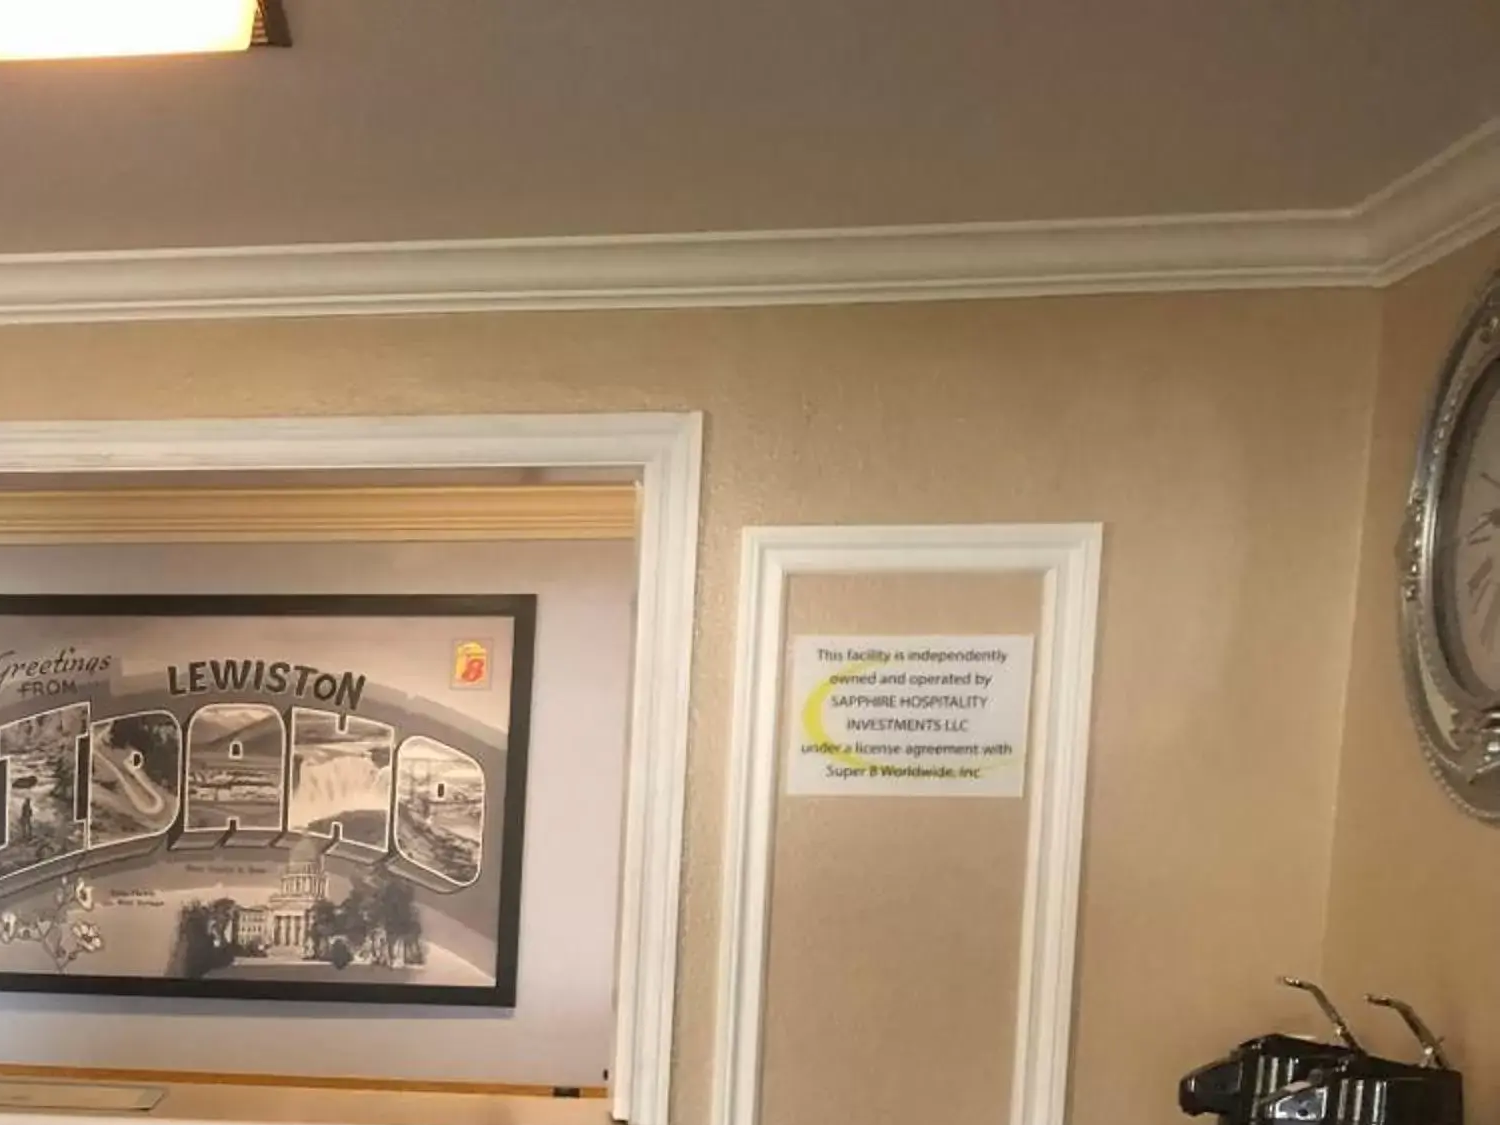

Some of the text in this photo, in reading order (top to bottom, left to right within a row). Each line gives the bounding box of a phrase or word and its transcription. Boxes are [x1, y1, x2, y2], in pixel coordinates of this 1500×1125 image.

[818, 649, 1007, 664] This facility is independently
[167, 658, 366, 711] LEWISTON
[829, 672, 992, 688] owned and operated by
[17, 679, 78, 697] FROM
[831, 695, 988, 709] SAPPHIRE HOSPITALITY
[847, 719, 969, 732] INVESTMENTS LLC
[801, 742, 841, 754] under
[855, 743, 901, 755] license
[905, 744, 979, 758] agreement
[983, 743, 1012, 756] with
[826, 765, 865, 780] Super
